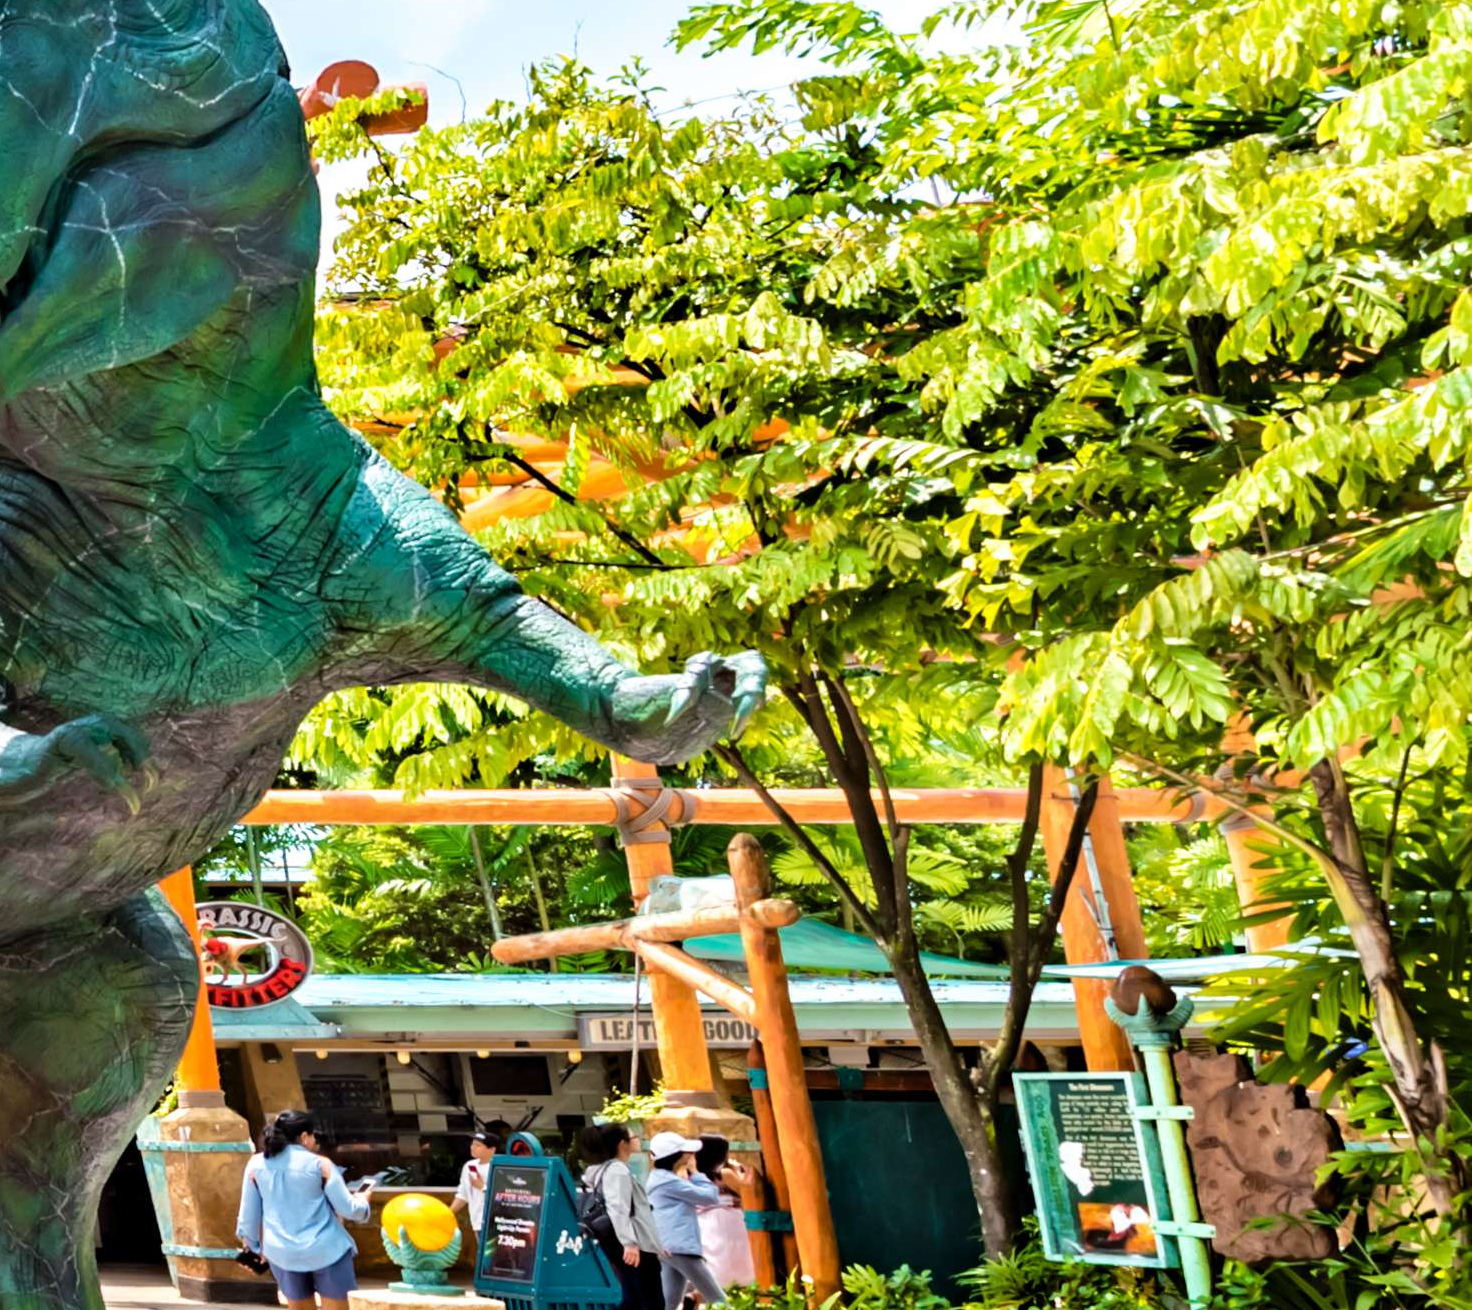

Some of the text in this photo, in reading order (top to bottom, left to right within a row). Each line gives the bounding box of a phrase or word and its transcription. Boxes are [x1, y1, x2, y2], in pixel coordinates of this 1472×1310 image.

[198, 907, 287, 940] RASSIC
[600, 1020, 760, 1041] LEAT GOOD
[495, 1193, 541, 1204] AFTER HOURS
